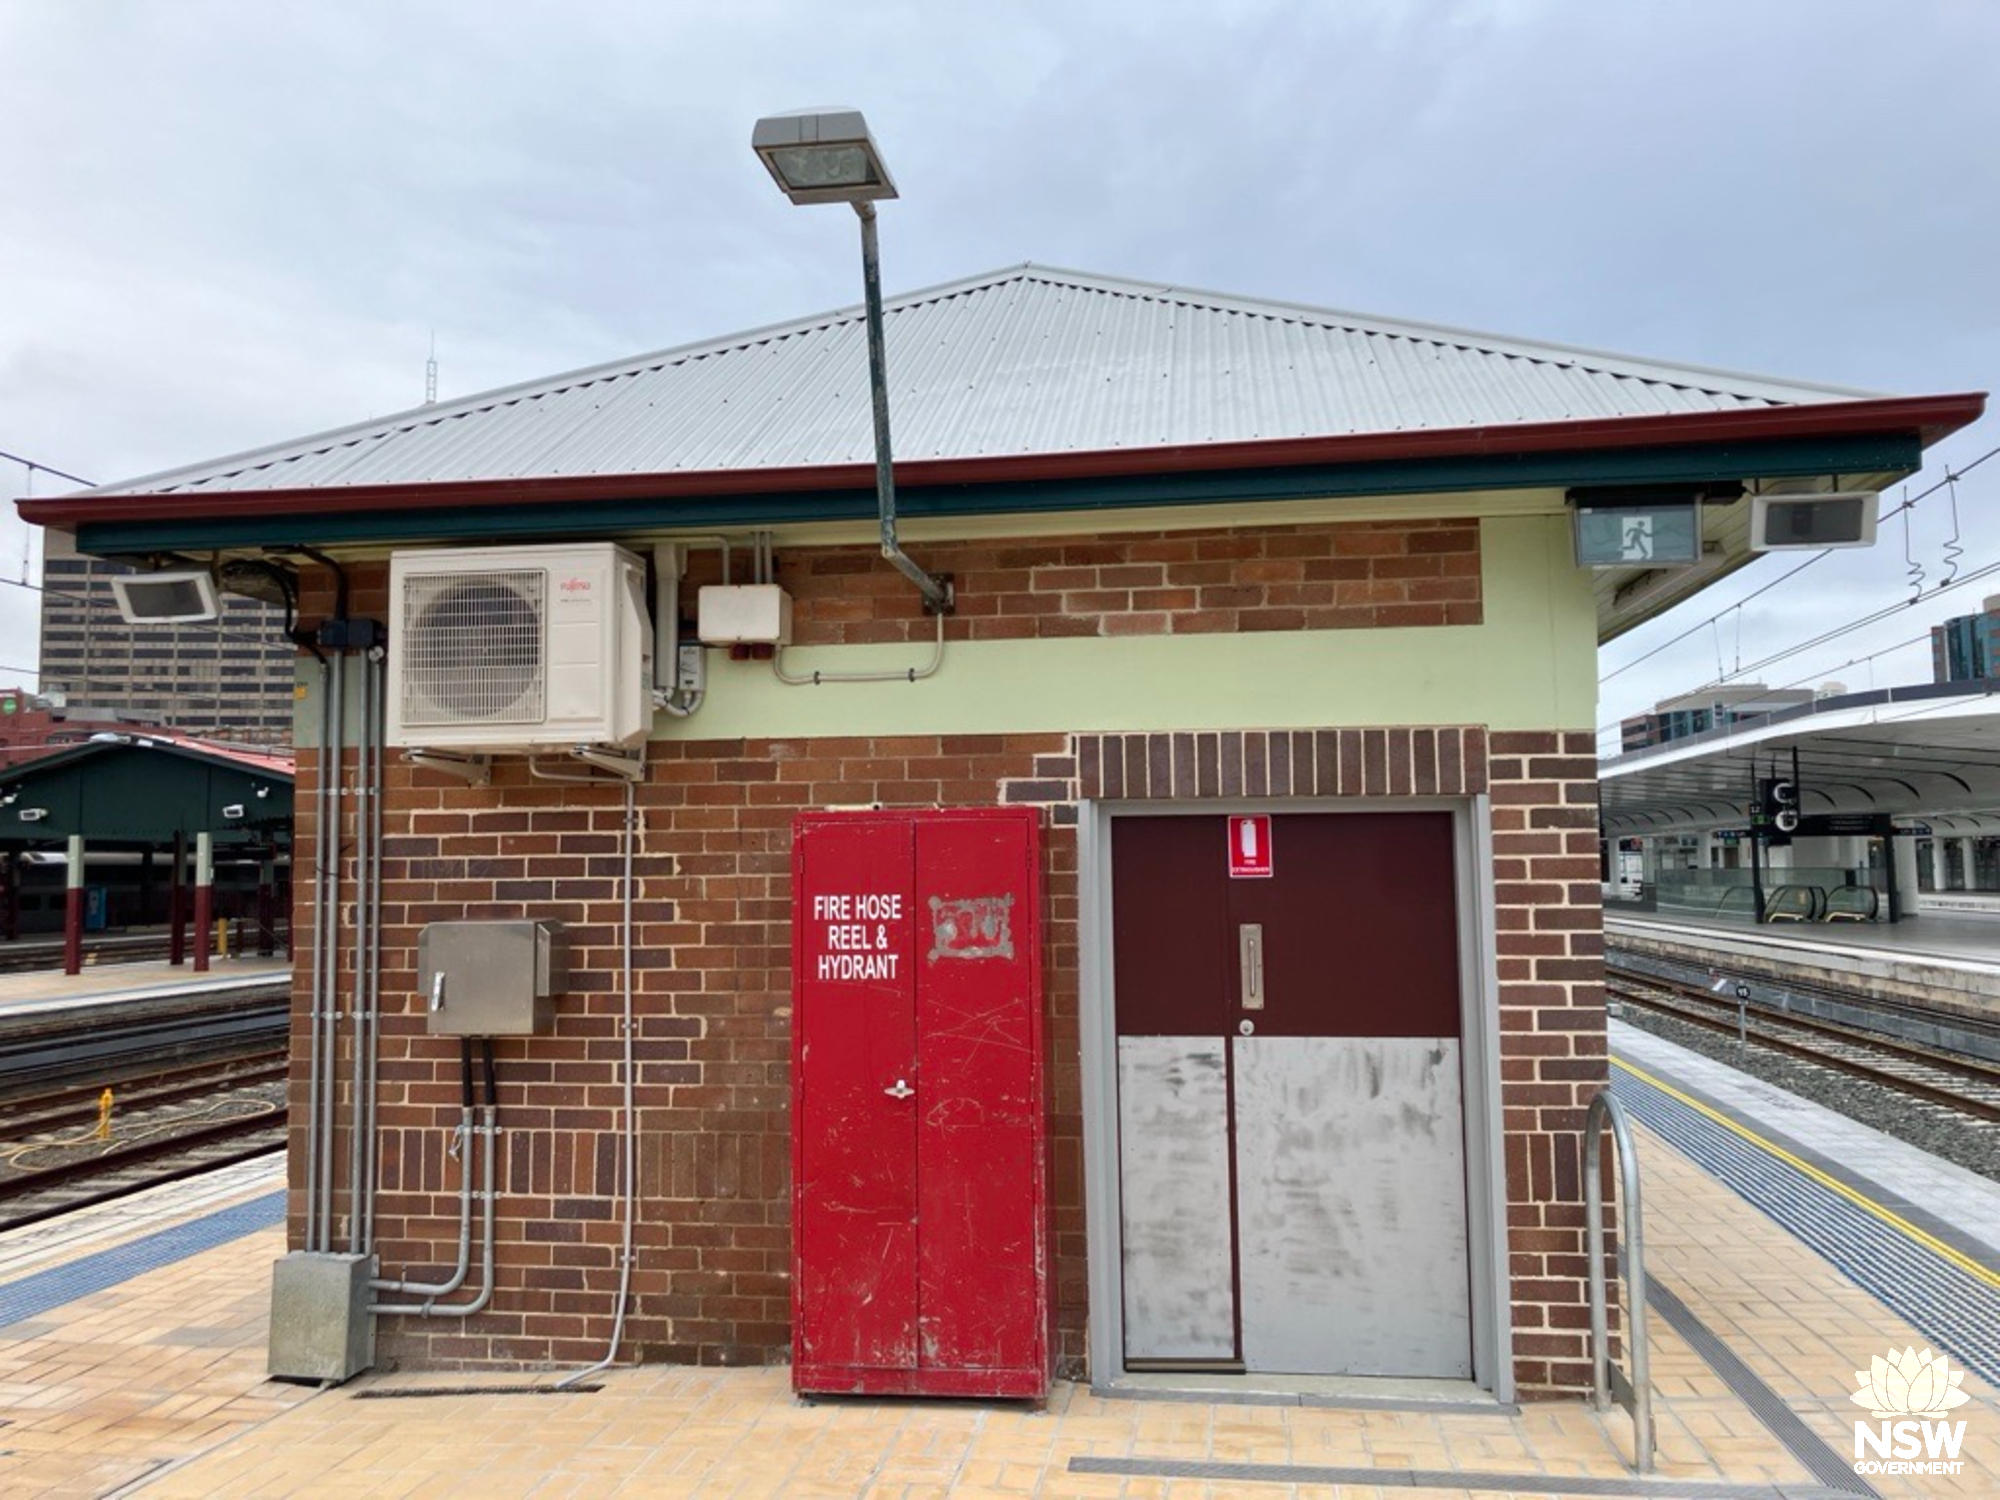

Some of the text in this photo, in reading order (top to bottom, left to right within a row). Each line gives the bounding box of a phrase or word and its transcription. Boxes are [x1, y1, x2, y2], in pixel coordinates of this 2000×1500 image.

[814, 895, 902, 920] FIRE HOSE
[828, 924, 888, 949] REEL &
[818, 954, 899, 979] HYDRANT
